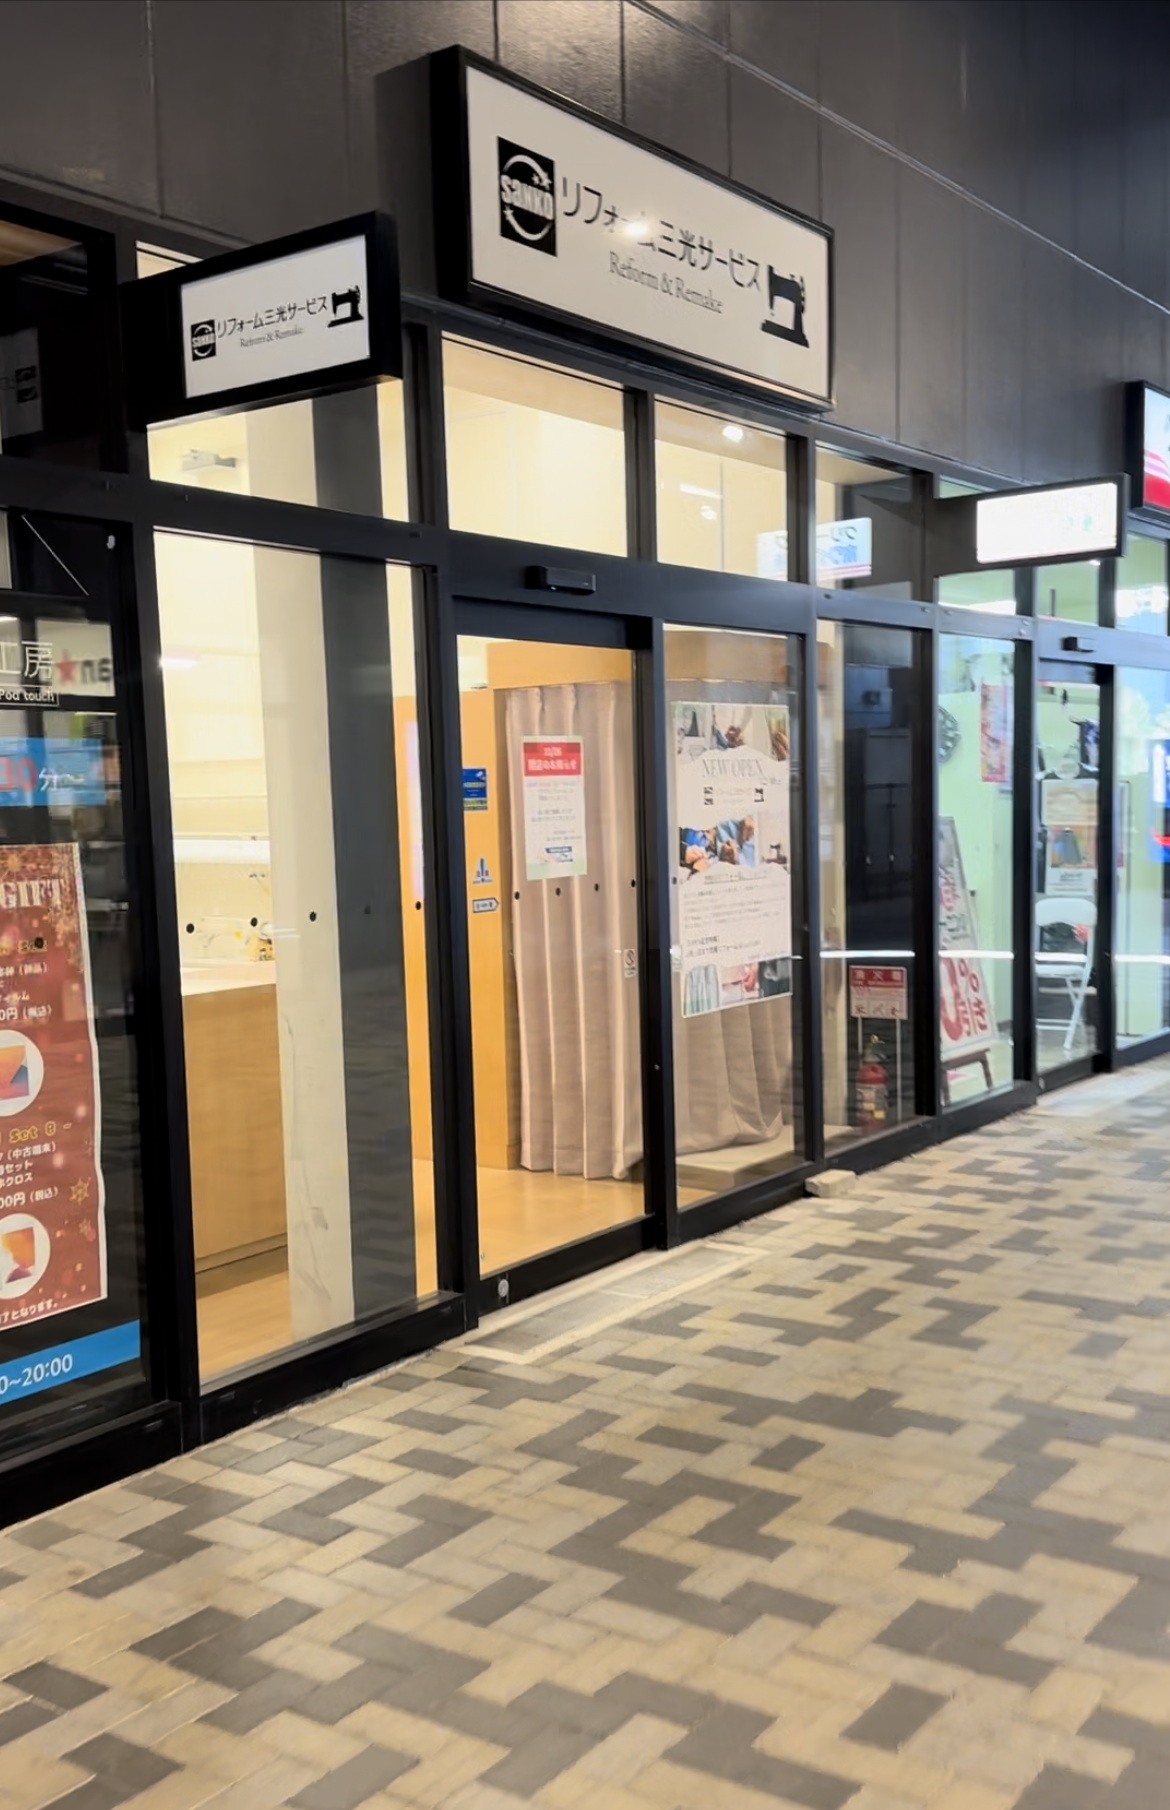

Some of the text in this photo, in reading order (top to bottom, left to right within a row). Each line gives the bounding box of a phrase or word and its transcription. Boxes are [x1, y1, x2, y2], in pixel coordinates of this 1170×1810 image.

[609, 250, 723, 314] Reform & Remake
[217, 295, 327, 339] リフォーム三光サービス
[9, 1126, 39, 1143] Set
